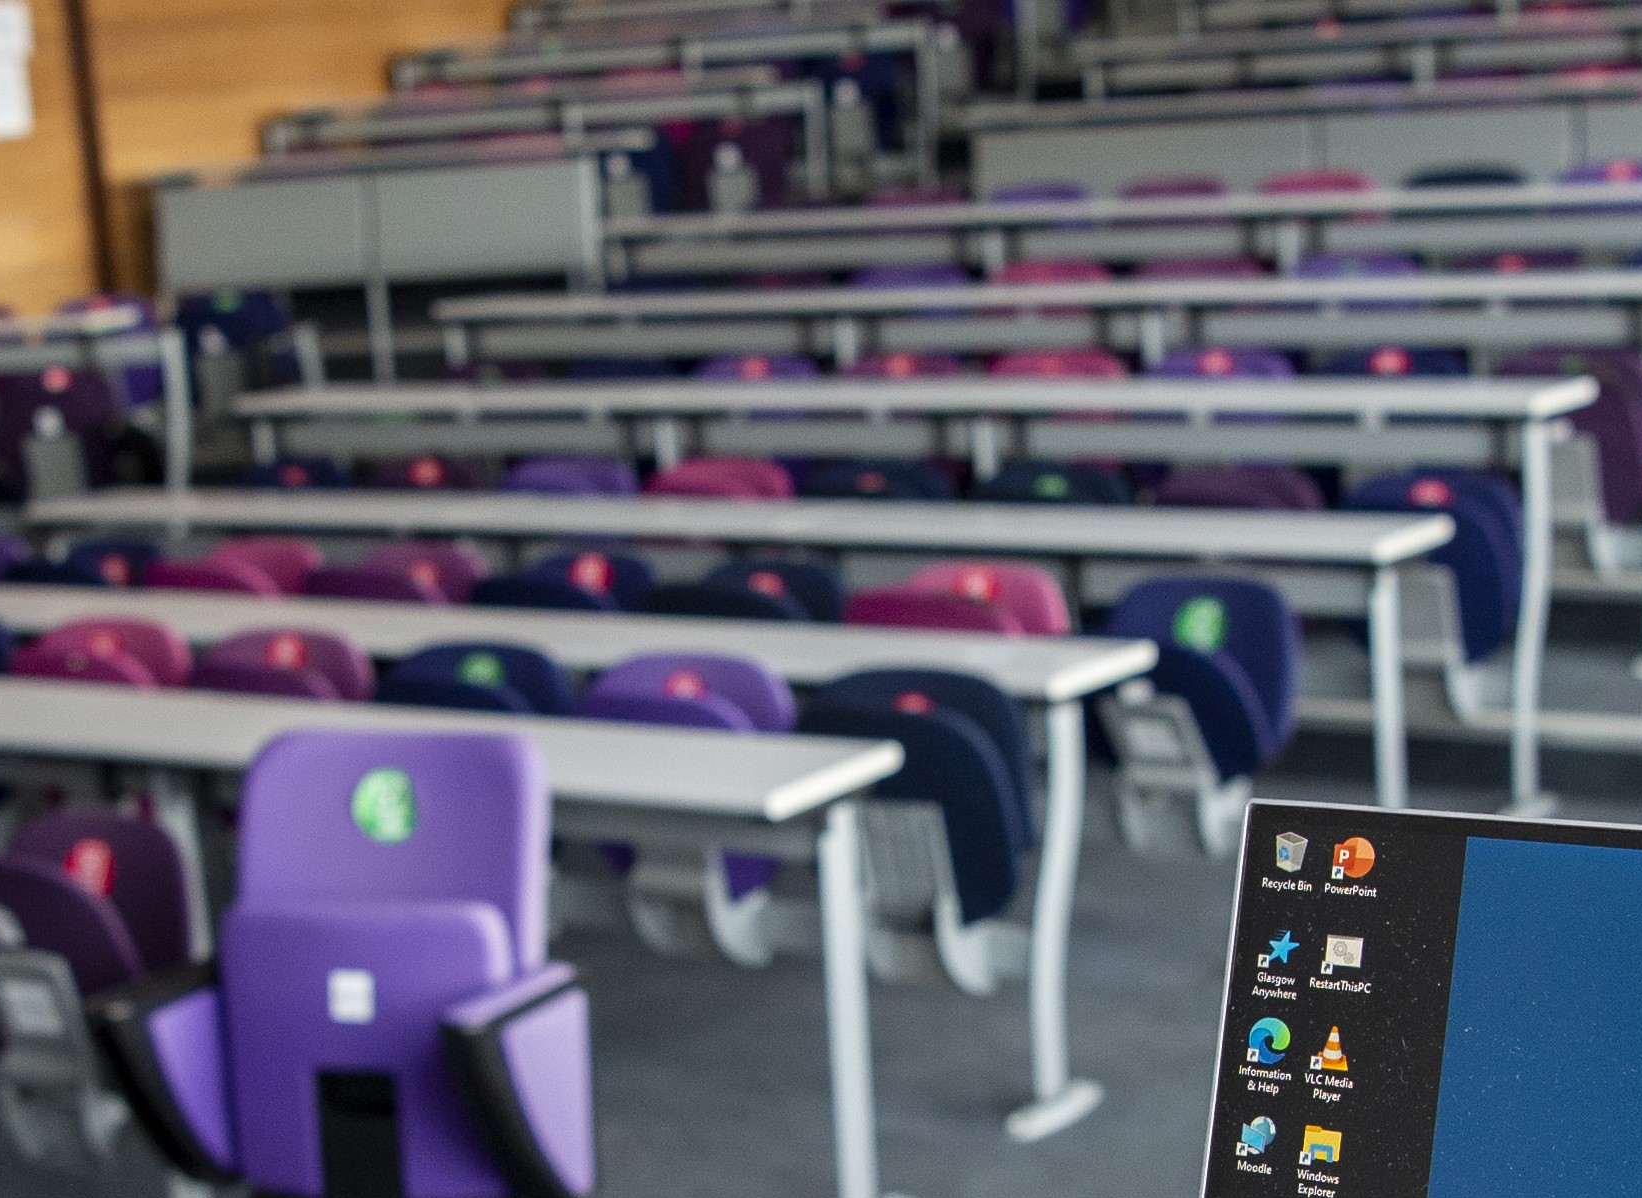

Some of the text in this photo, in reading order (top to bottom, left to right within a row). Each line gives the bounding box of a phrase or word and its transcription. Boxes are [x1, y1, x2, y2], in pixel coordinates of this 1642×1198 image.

[1262, 877, 1312, 891] Recycle Bin
[1325, 883, 1376, 897] PowerPoint
[1258, 972, 1295, 986] Glasgow
[1310, 977, 1371, 993] RestartThisPC
[1252, 985, 1296, 1000] Anywhere
[1239, 1065, 1291, 1080] Information
[1248, 1080, 1279, 1095] & Help
[1305, 1073, 1353, 1088] VLC Media
[1312, 1088, 1341, 1102] Player
[1237, 1160, 1271, 1174] Moodle
[1297, 1169, 1339, 1186] Windows
[1298, 1183, 1335, 1198] Explorer
